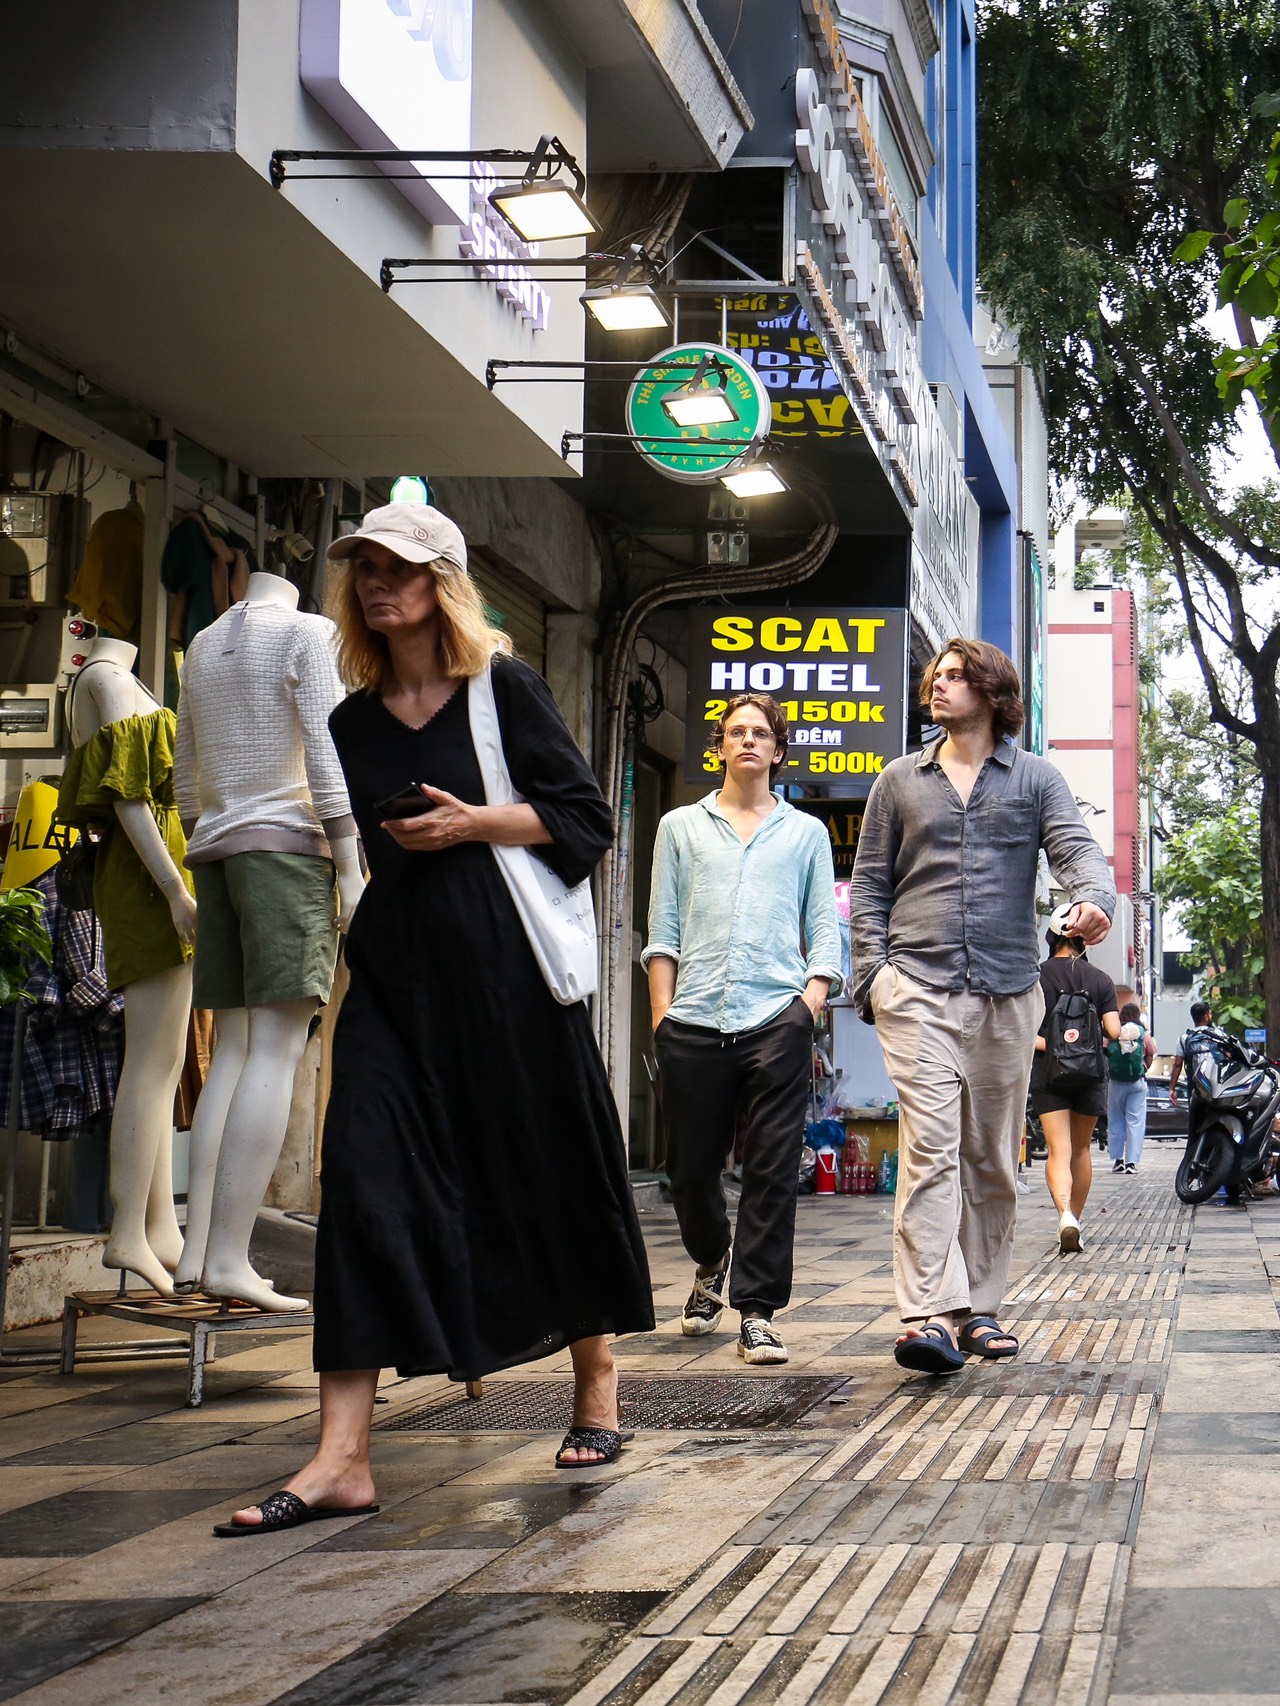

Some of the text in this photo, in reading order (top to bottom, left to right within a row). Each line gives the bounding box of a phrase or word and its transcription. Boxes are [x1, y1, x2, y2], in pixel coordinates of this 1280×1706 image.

[471, 212, 551, 332] SEVENTY
[637, 380, 656, 405] THE
[711, 616, 885, 653] SCAT
[710, 662, 881, 692] HOTEL
[781, 700, 886, 723] 150k
[795, 727, 842, 745] ĐÊM
[809, 751, 885, 774] 500k
